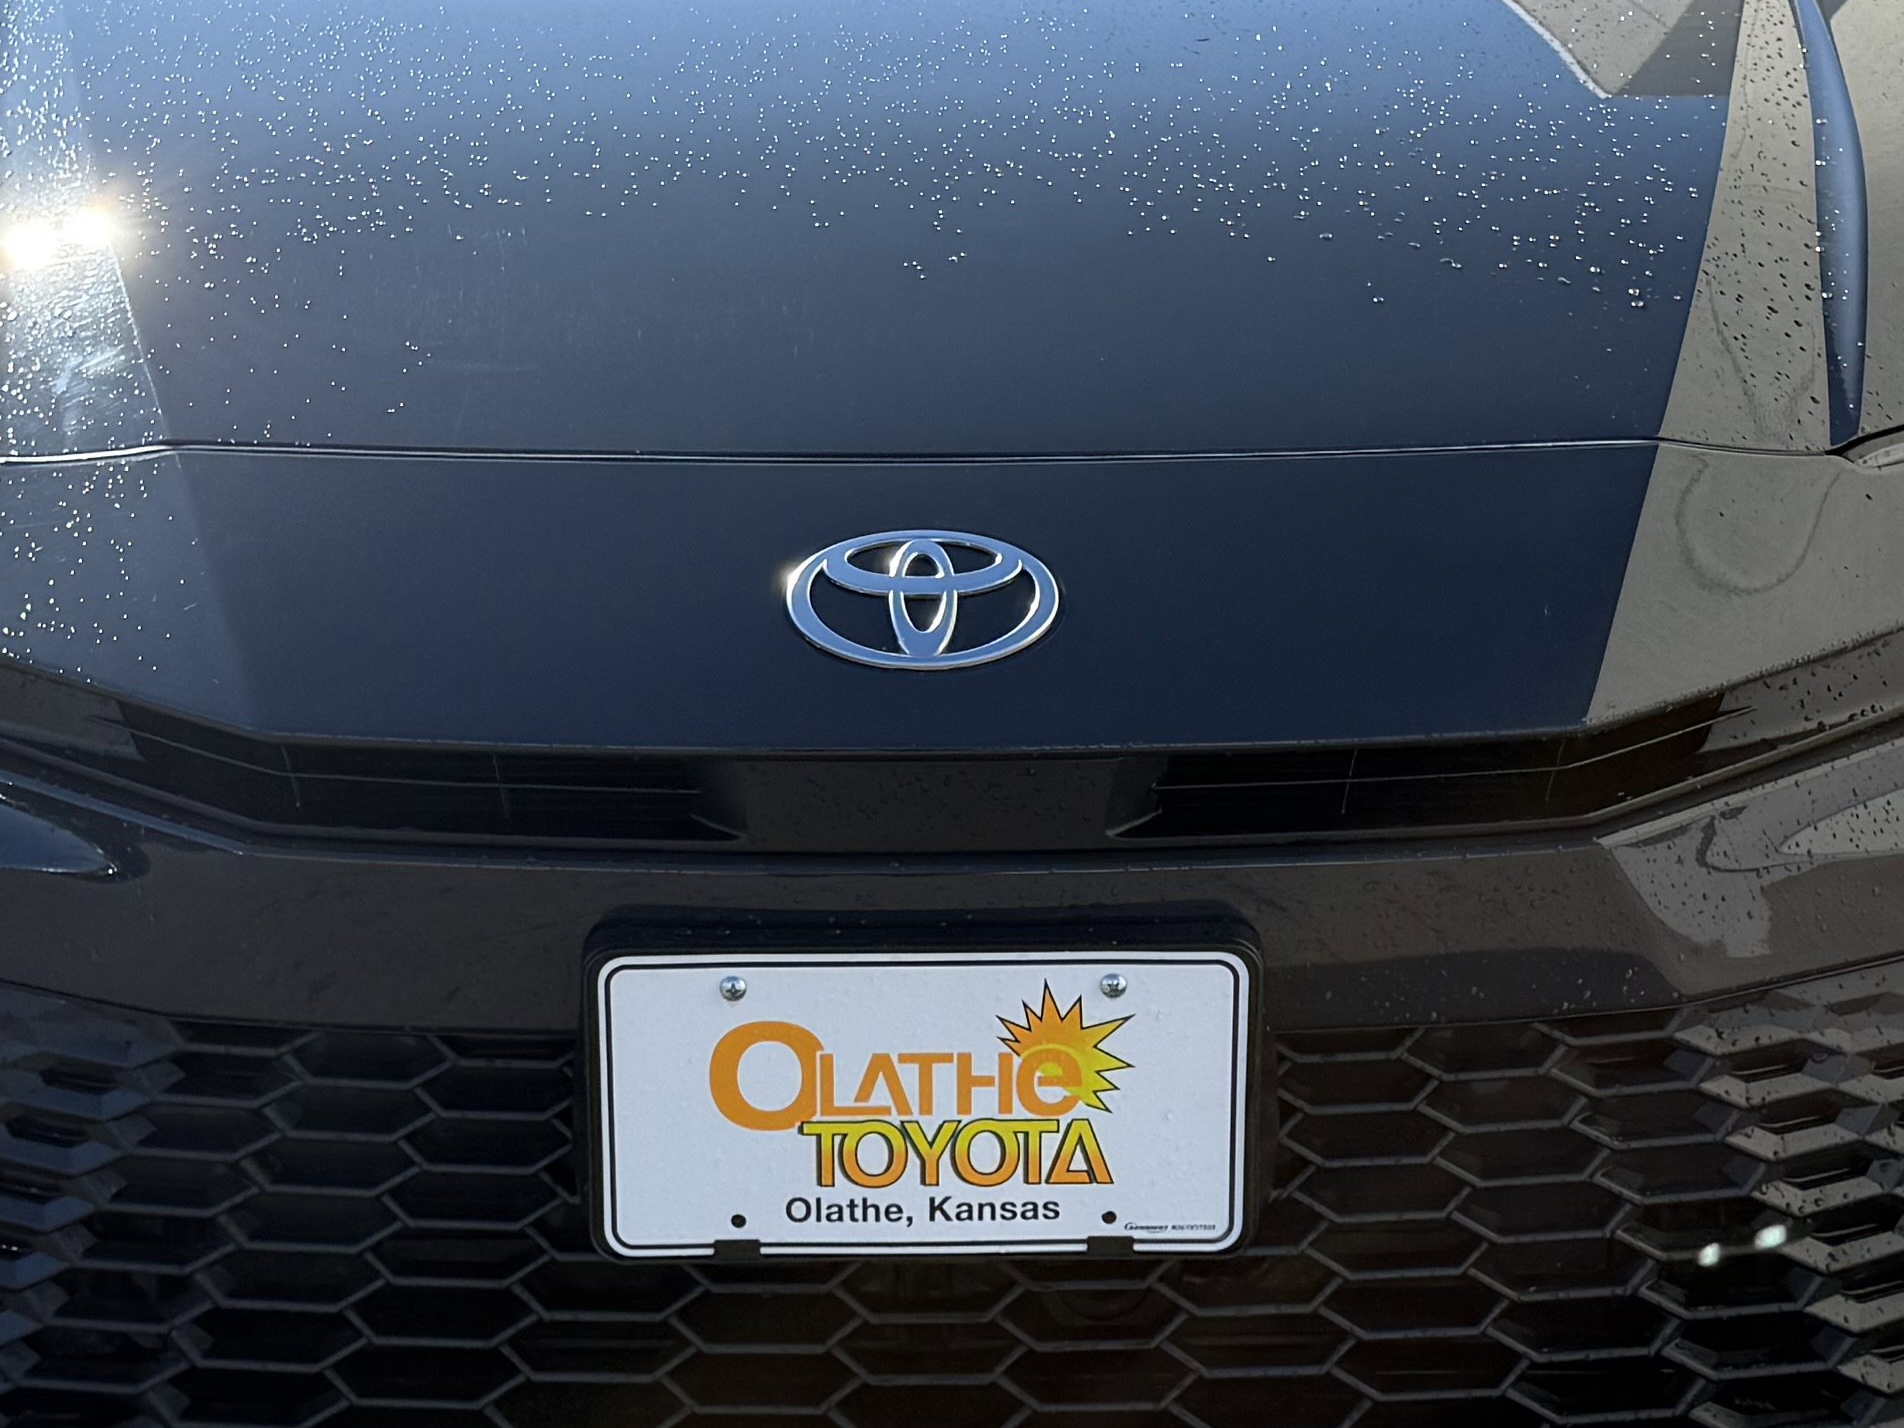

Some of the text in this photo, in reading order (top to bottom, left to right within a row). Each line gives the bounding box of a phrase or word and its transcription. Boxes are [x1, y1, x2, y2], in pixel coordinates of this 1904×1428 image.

[799, 1118, 1115, 1189] TOYOTA
[785, 1195, 1061, 1226] Olathe, Kansas
